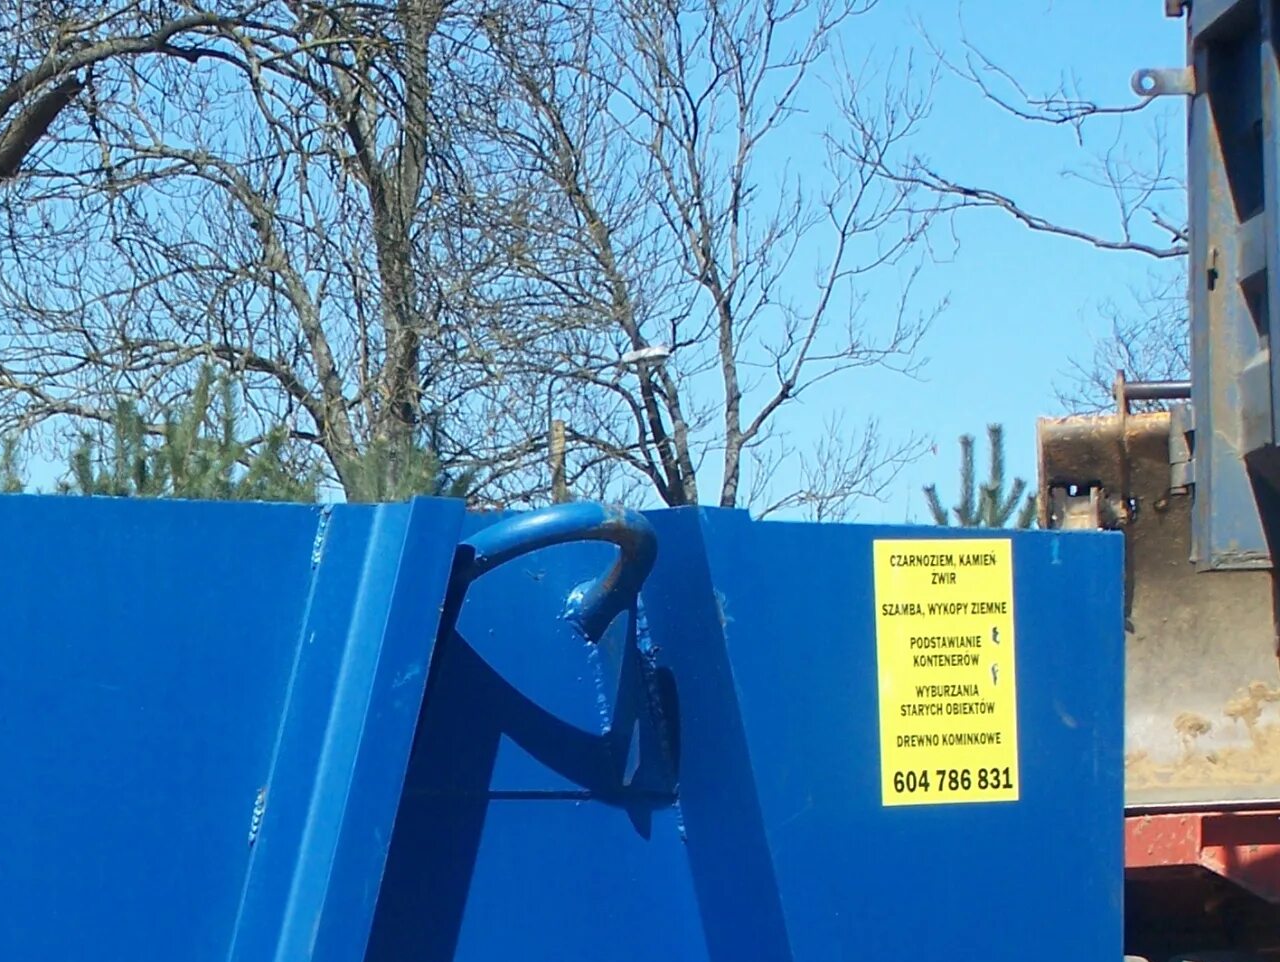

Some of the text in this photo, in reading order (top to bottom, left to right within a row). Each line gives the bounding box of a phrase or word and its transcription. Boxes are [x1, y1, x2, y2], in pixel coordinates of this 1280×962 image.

[889, 553, 957, 568] CZARNOZIEM,
[882, 601, 1007, 618] SZAMBA, WYKOPY ZIEMNE
[910, 635, 982, 649] PODSTAWIANIE
[913, 650, 980, 667] KONTENERÓW
[915, 684, 979, 698] WYBURZANIA
[900, 698, 995, 717] STARYCH OBIEKTÓW
[896, 731, 1002, 748] DREWNO KOMINKOWE
[893, 766, 1013, 793] 604 786 831
